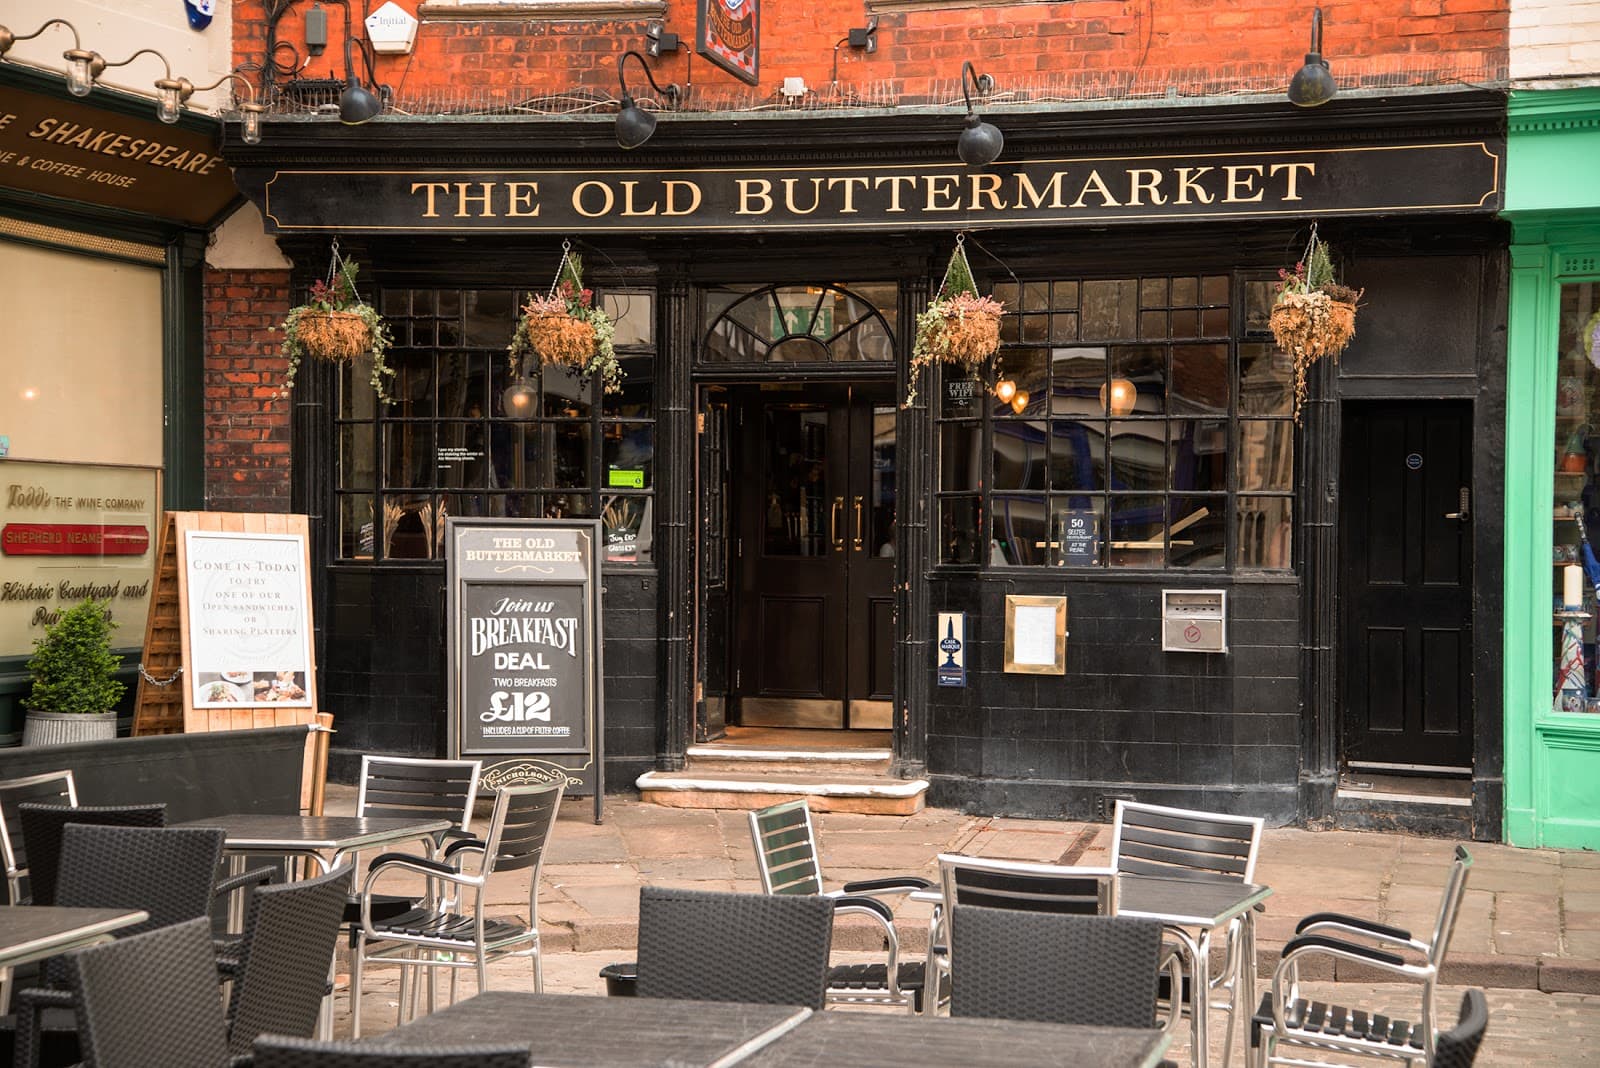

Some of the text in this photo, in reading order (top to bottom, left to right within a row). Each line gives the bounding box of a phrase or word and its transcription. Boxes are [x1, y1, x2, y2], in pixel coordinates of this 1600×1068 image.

[379, 16, 407, 25] Initial
[29, 118, 223, 175] SHAKESPEARE
[17, 156, 30, 166] &
[31, 159, 86, 178] COFFEE
[87, 170, 136, 188] HOUSE
[411, 162, 1315, 218] THE OLD BUTTERMARKET
[7, 484, 145, 510] Todd's THE WINE COMPANY
[1071, 518, 1084, 528] 50
[6, 531, 62, 545] SHEPHERD
[66, 532, 103, 545] NEAME
[492, 537, 555, 549] THE OLD
[465, 550, 582, 562] BUTTERMARKET
[1, 579, 149, 601] Historic Courtyard and
[490, 597, 555, 615] Join us
[471, 617, 578, 657] BREAKFAST
[494, 652, 550, 670] DEAL
[492, 677, 557, 687] TWO BREAKFASTS
[480, 691, 551, 722] £12
